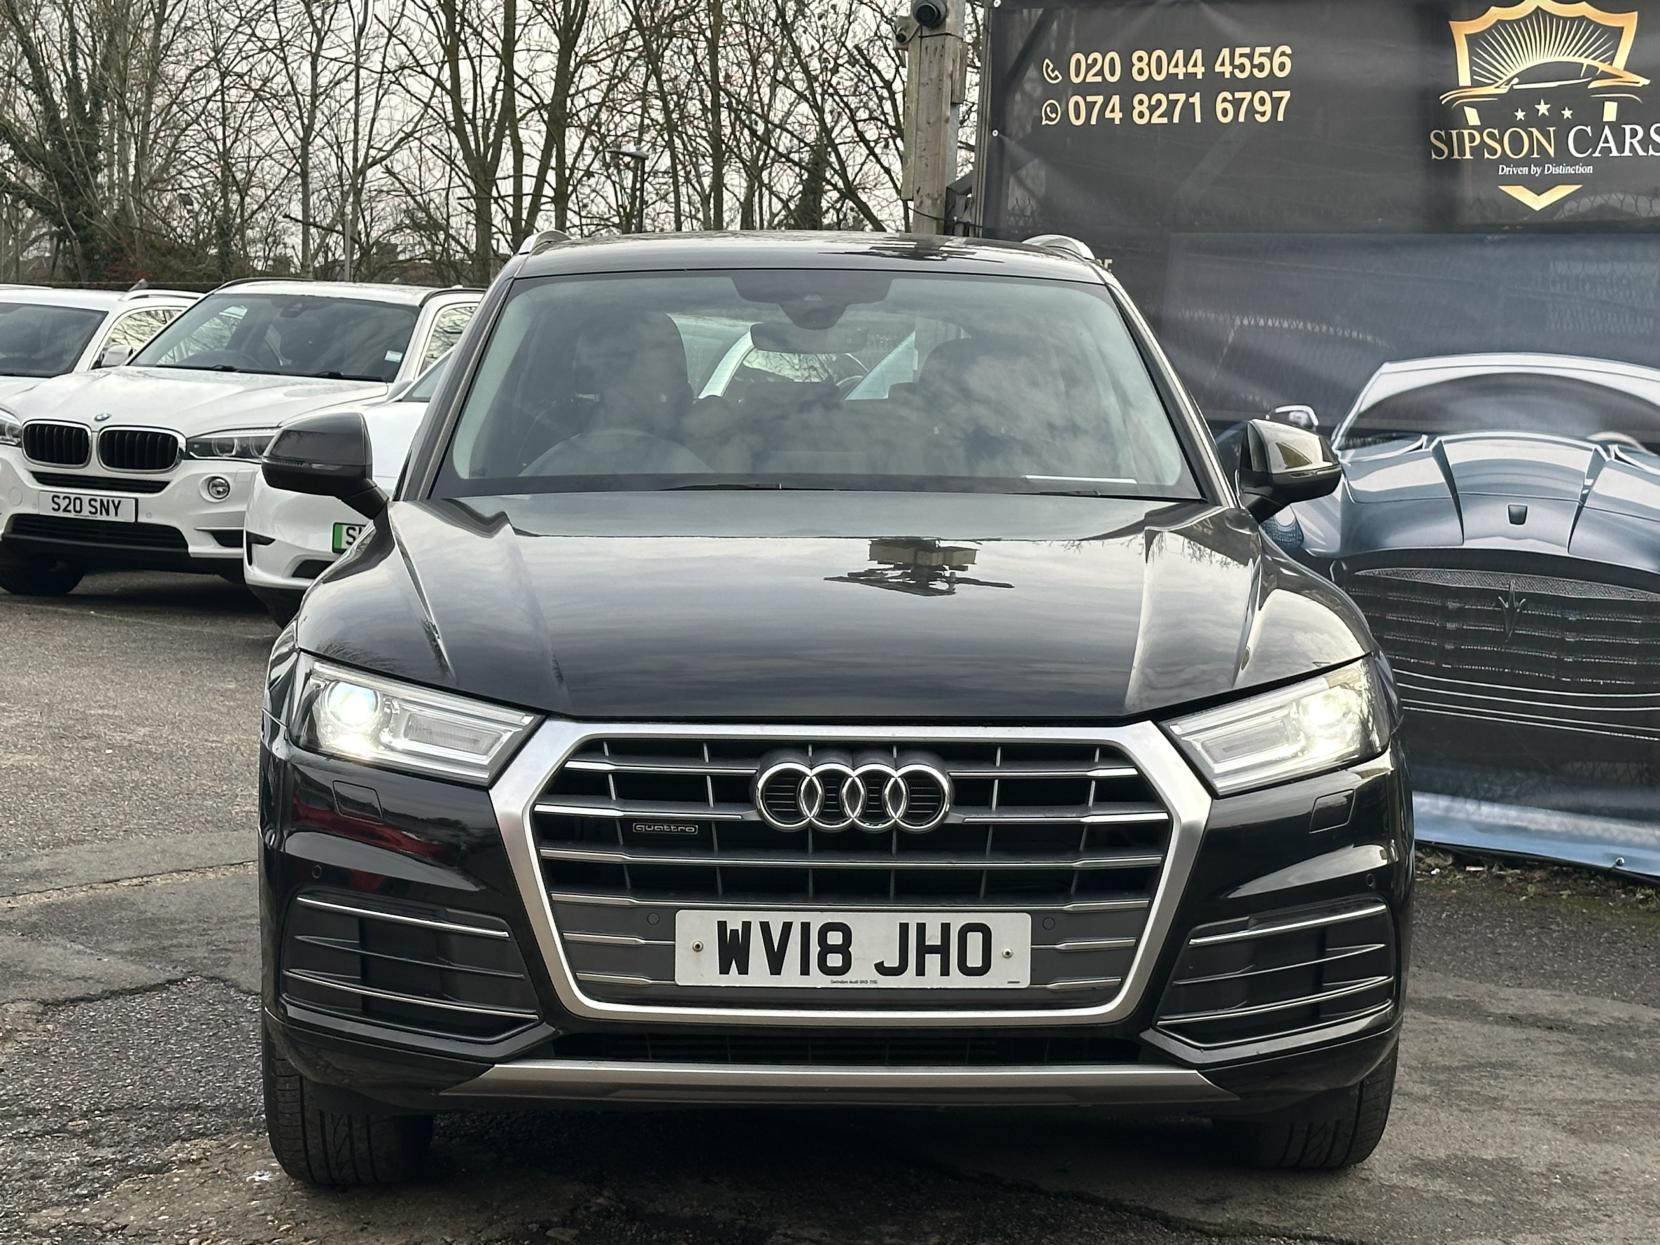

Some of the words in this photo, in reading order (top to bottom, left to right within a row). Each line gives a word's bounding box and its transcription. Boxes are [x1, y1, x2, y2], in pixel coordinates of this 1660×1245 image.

[1069, 51, 1121, 84] 020
[1131, 49, 1205, 82] 8044
[1214, 45, 1292, 79] 4556
[1068, 95, 1123, 126] 074
[1132, 92, 1201, 125] 8271
[1215, 90, 1291, 124] 6797
[1429, 127, 1556, 160] SIPSON
[1498, 163, 1529, 175] Driven
[1530, 163, 1542, 177] by
[1544, 162, 1593, 175] Distinction
[51, 494, 83, 514] S20
[88, 498, 121, 517] SNY
[346, 526, 362, 546] S
[635, 824, 695, 833] quattro
[717, 920, 853, 976] WV18
[873, 922, 992, 977] JHO
